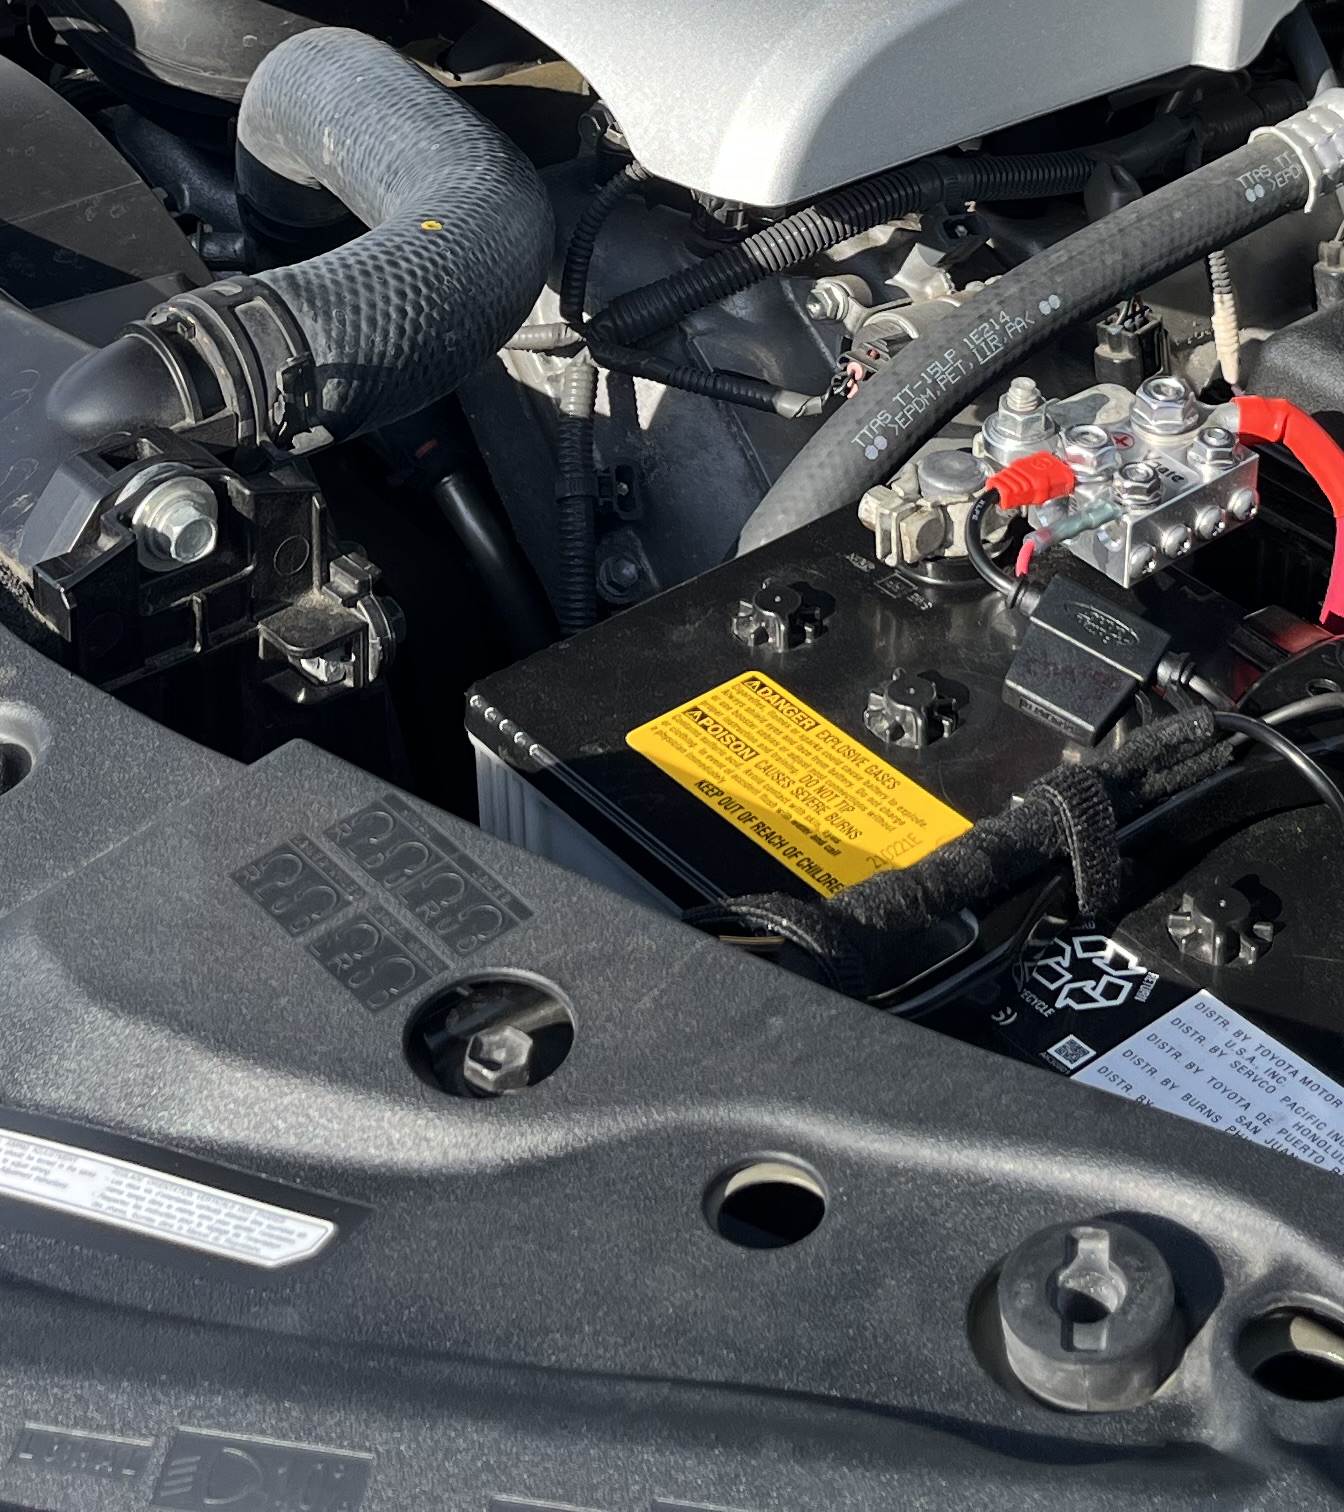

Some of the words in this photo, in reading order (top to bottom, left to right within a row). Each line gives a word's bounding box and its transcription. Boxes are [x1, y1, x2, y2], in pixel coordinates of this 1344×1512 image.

[851, 409, 893, 448] TTAS
[892, 348, 957, 407] TT-15LP
[962, 310, 1011, 350] 1E214
[694, 716, 758, 760] POISON
[752, 758, 797, 789] CAUSES
[787, 786, 831, 815] SEVERE
[821, 811, 865, 840] BURNS
[753, 685, 819, 730] DANGER
[813, 729, 871, 767] EXPLOSIVE
[862, 763, 902, 790] GASES
[692, 778, 726, 800] KEEP
[715, 795, 746, 815] OUT
[735, 810, 759, 825] OF
[748, 820, 791, 849] REACH
[781, 844, 806, 860] OF
[796, 773, 821, 789] DO
[811, 784, 840, 803] NOT
[832, 799, 857, 815] TIP
[1095, 1065, 1139, 1096] DISTR.
[1119, 1048, 1163, 1079] DISTR.
[1158, 1077, 1180, 1092] BY
[1179, 1092, 1224, 1123] BURNS
[1144, 1032, 1187, 1063] DISTR.
[1183, 1060, 1204, 1075] BY
[1204, 1075, 1253, 1110] TOYOTA
[1253, 1111, 1275, 1126] DE
[1274, 1127, 1327, 1164] PUERTO
[1168, 1016, 1211, 1047] DISTR.
[1208, 1044, 1228, 1059] BY
[1228, 1059, 1278, 1095] SERVCO
[1277, 1095, 1328, 1131] PACIFIC
[1192, 1001, 1234, 1031] DISTR.
[1231, 1028, 1252, 1043] BY
[1252, 1043, 1301, 1078] TOYOTA
[1297, 1075, 1344, 1108] MOTOR
[1233, 1114, 1263, 1135] SAN
